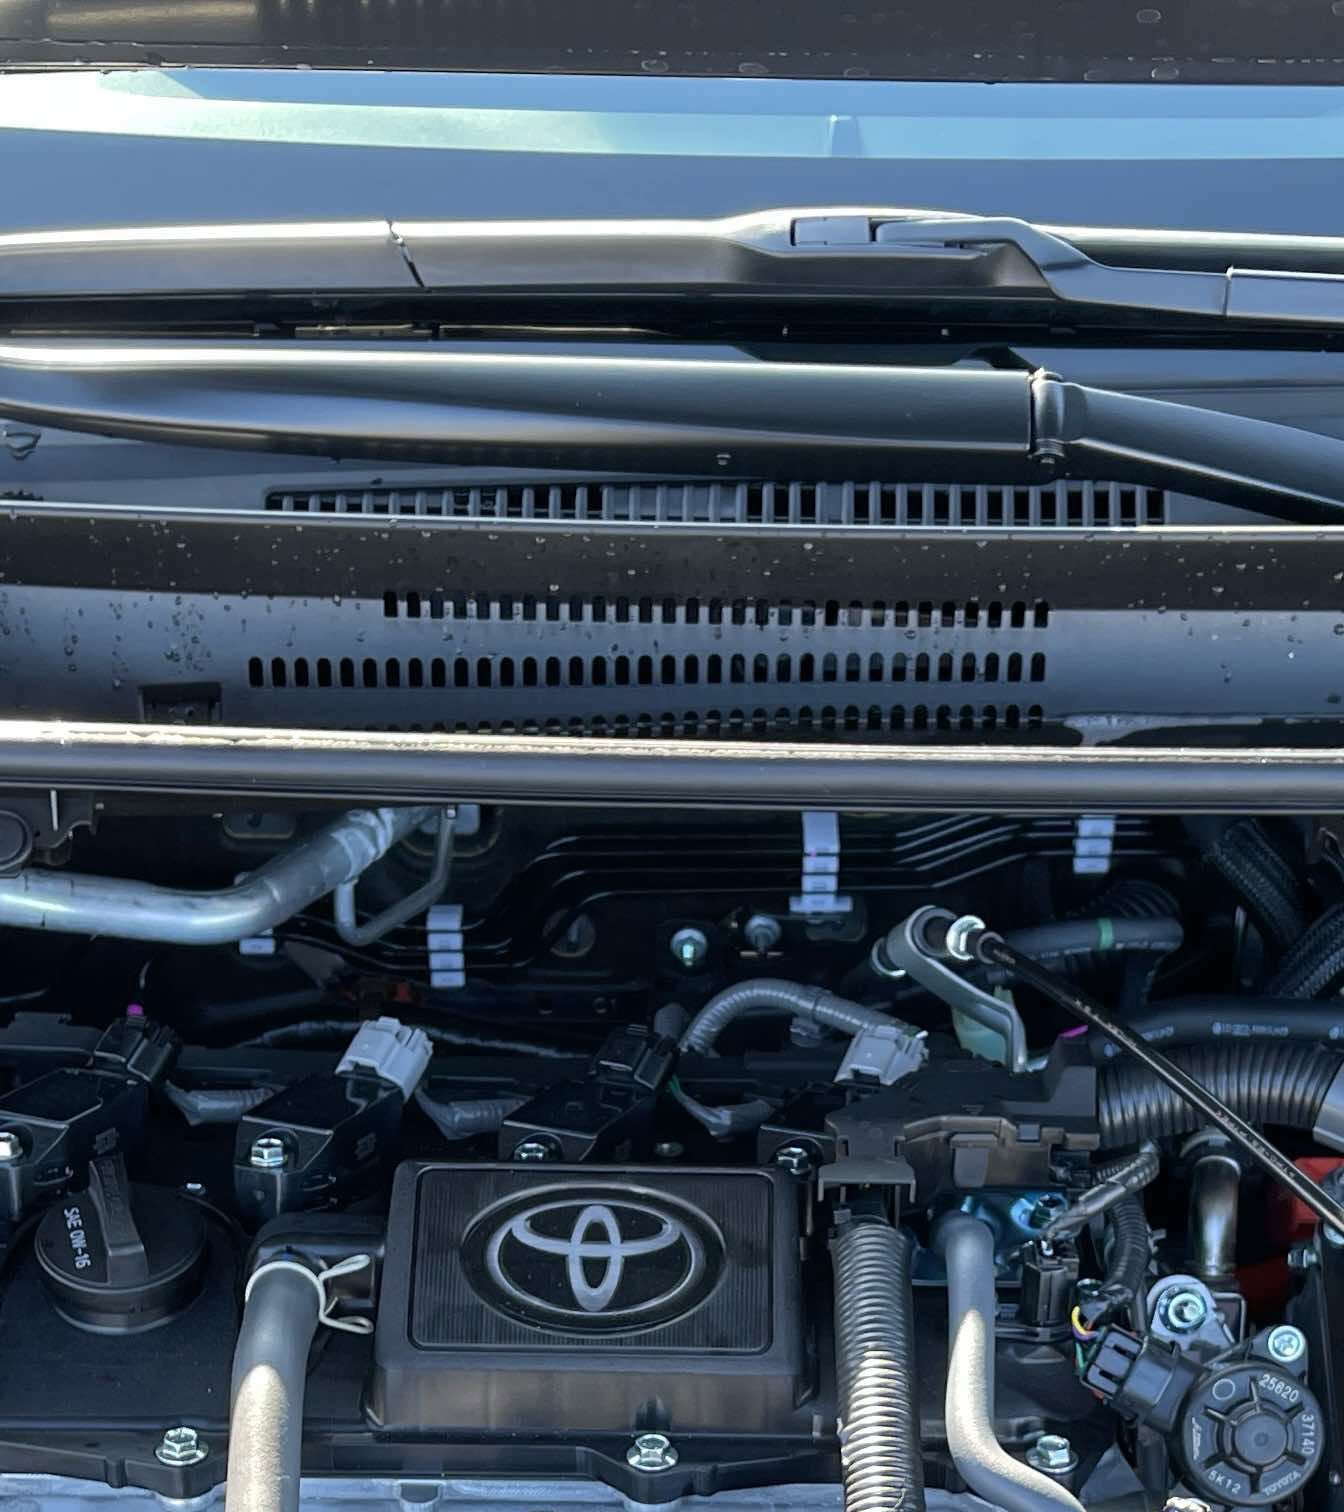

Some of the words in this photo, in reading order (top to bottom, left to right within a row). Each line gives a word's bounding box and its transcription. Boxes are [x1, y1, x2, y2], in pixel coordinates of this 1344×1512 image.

[63, 1207, 82, 1229] SAE
[69, 1231, 92, 1270] 0W-16
[1302, 1414, 1315, 1454] 37140
[1263, 1471, 1302, 1496] TOYOTA
